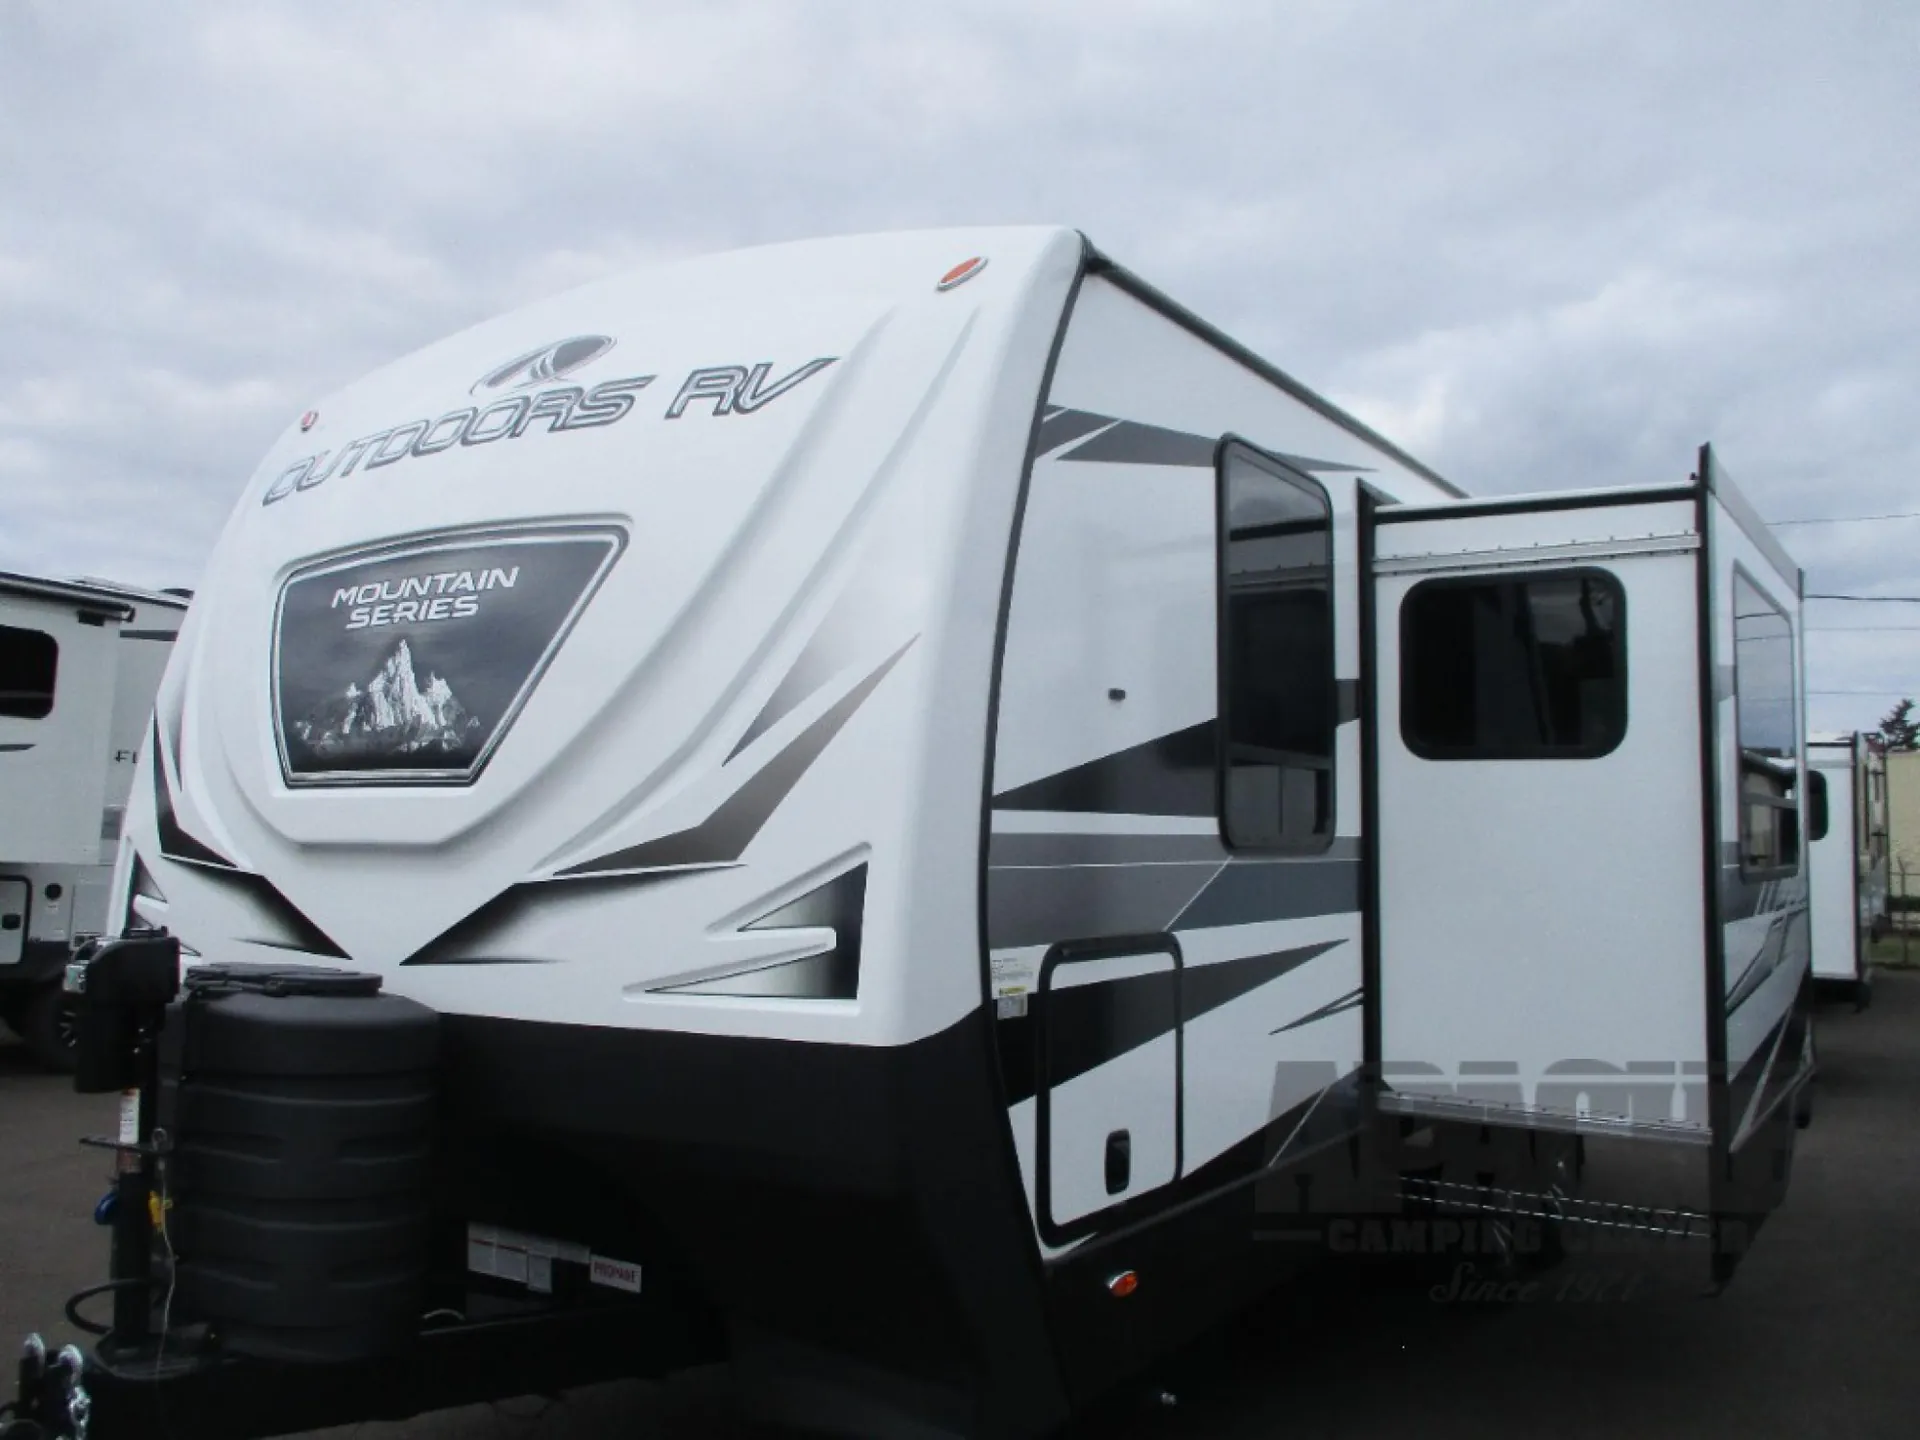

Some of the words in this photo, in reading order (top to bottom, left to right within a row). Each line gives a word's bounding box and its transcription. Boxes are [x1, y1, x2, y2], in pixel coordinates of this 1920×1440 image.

[262, 374, 657, 506] OUTDOORS
[664, 355, 840, 420] RV
[331, 566, 520, 608] MOUNTAIN
[345, 594, 480, 629] SERIES
